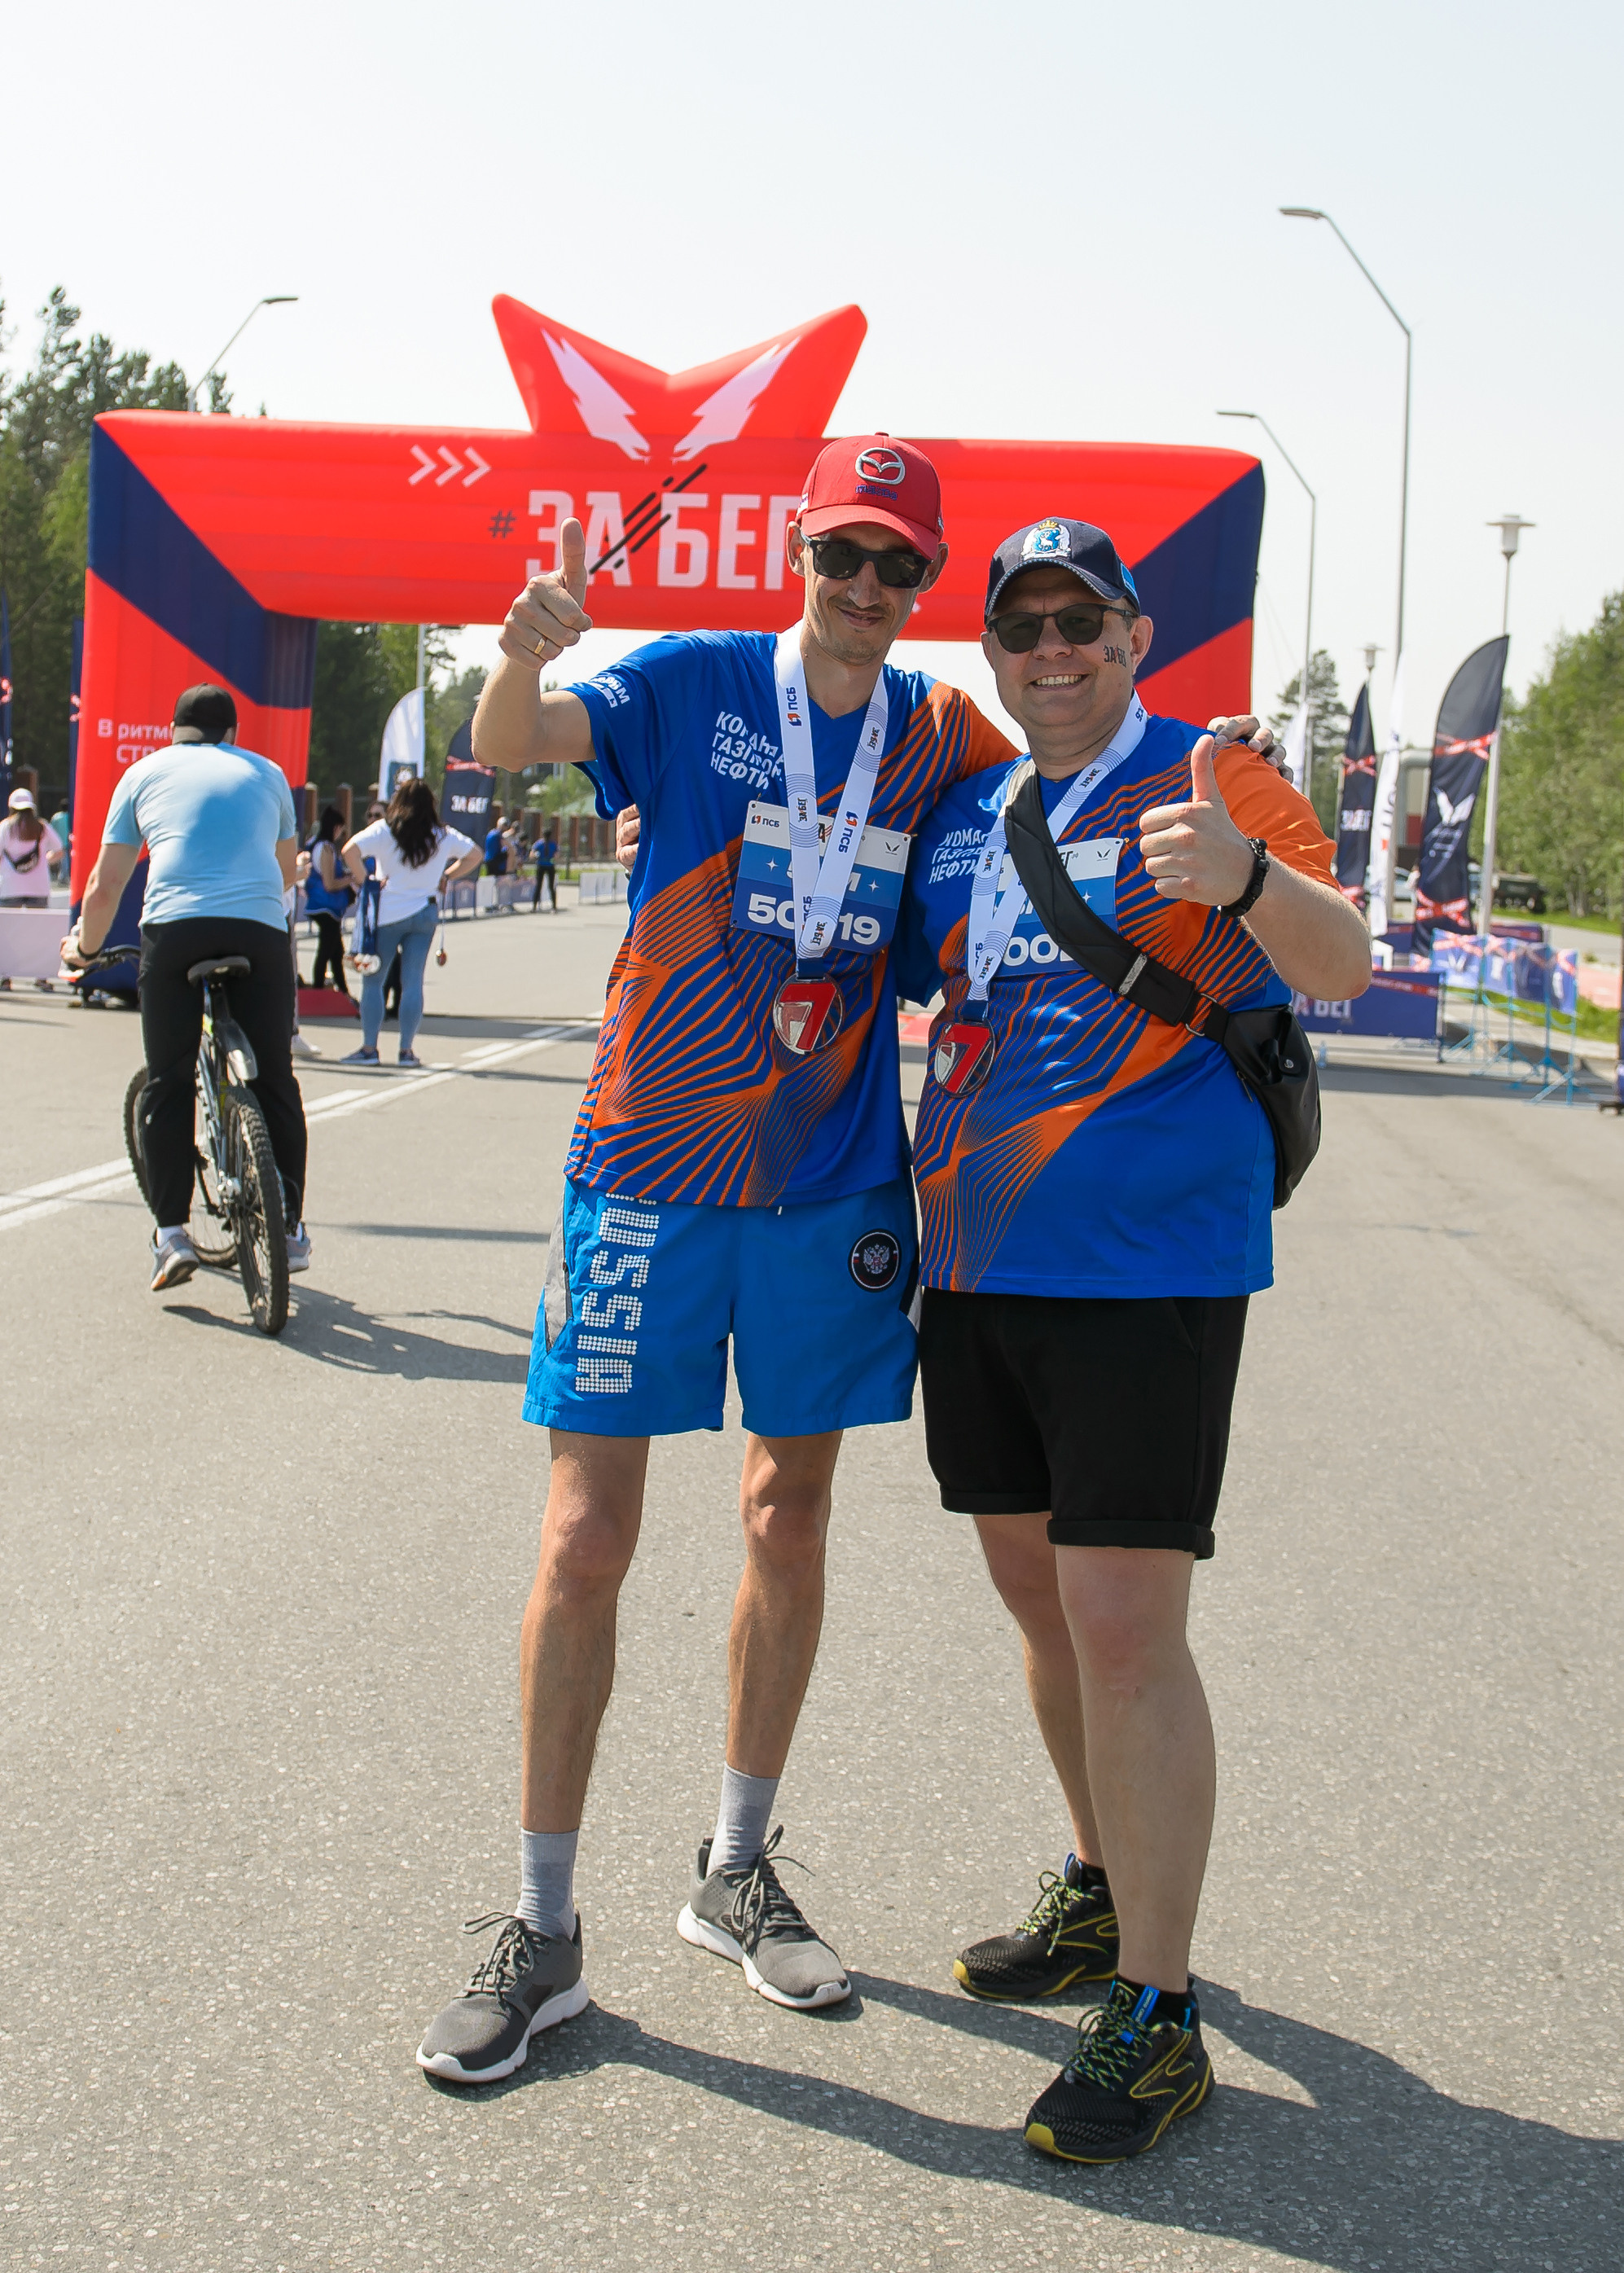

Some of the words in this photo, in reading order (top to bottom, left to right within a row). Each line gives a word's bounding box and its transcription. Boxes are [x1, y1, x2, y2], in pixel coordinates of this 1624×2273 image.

[786, 687, 797, 710] ПСБ
[97, 718, 113, 738] В
[117, 724, 173, 741] ритм
[710, 750, 770, 790] НЕФТИ
[762, 818, 780, 828] ПСБ
[838, 827, 854, 853] ПСБ
[747, 893, 880, 946] 5019
[575, 1192, 660, 1393] USSIA
